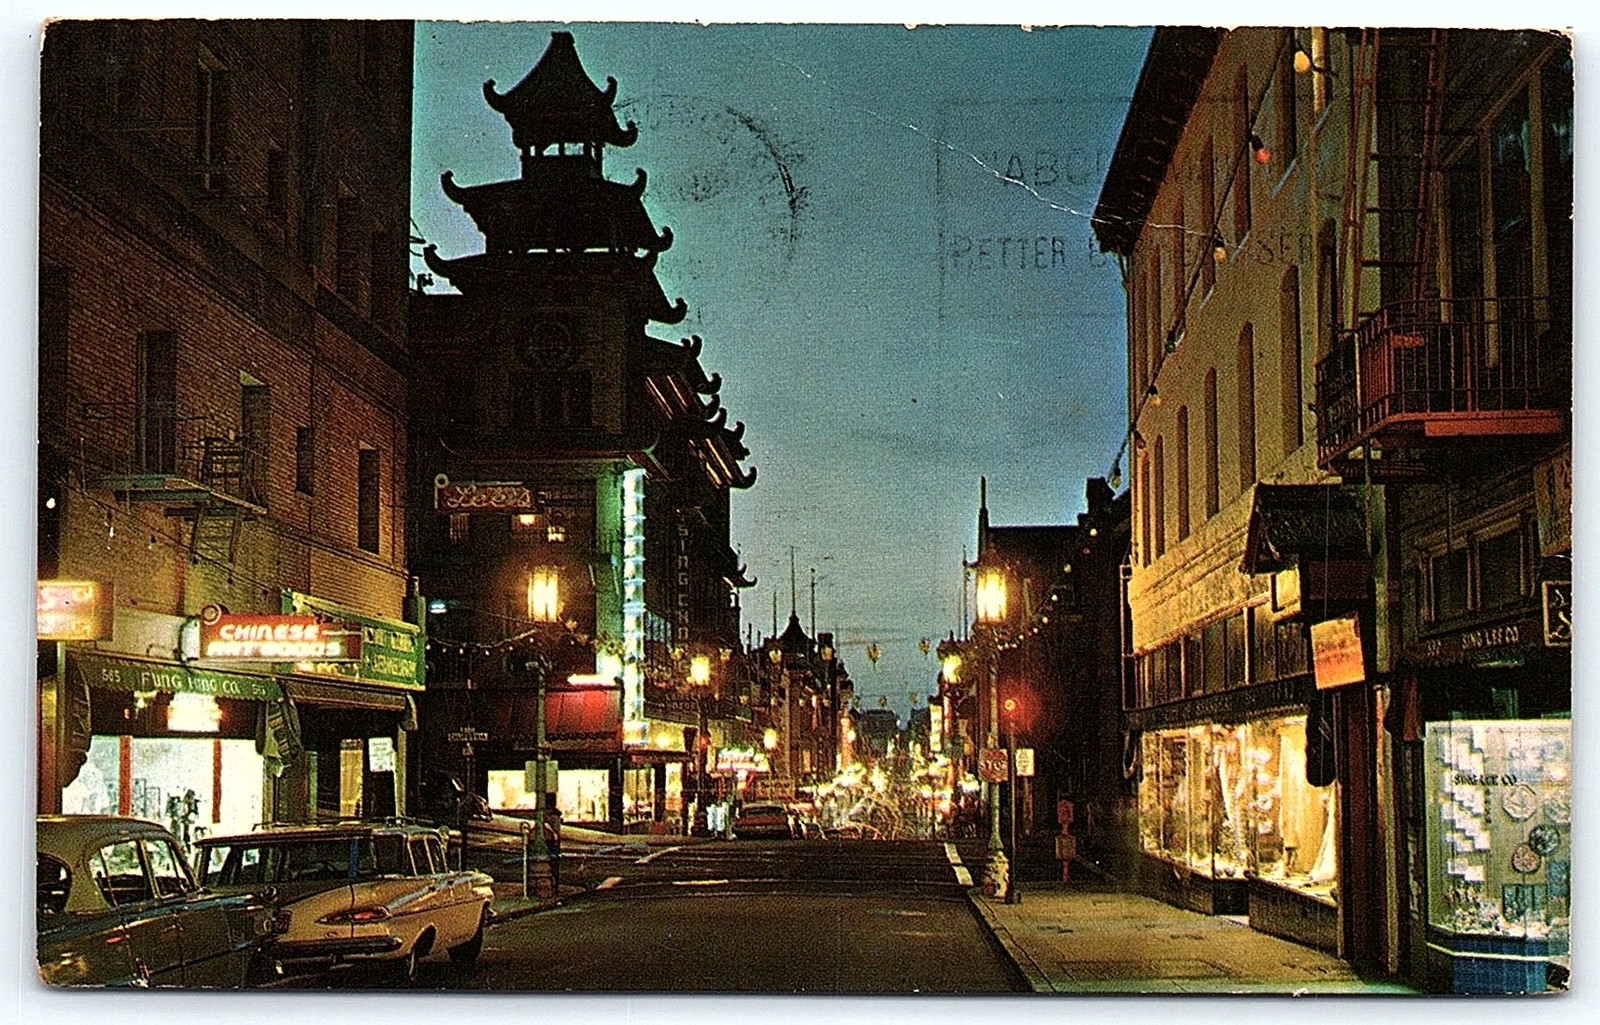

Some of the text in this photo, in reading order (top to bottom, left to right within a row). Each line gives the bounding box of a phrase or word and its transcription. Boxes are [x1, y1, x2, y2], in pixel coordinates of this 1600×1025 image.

[219, 624, 320, 641] CHINESE
[259, 641, 341, 657] GOODS
[141, 672, 182, 690] FUNG
